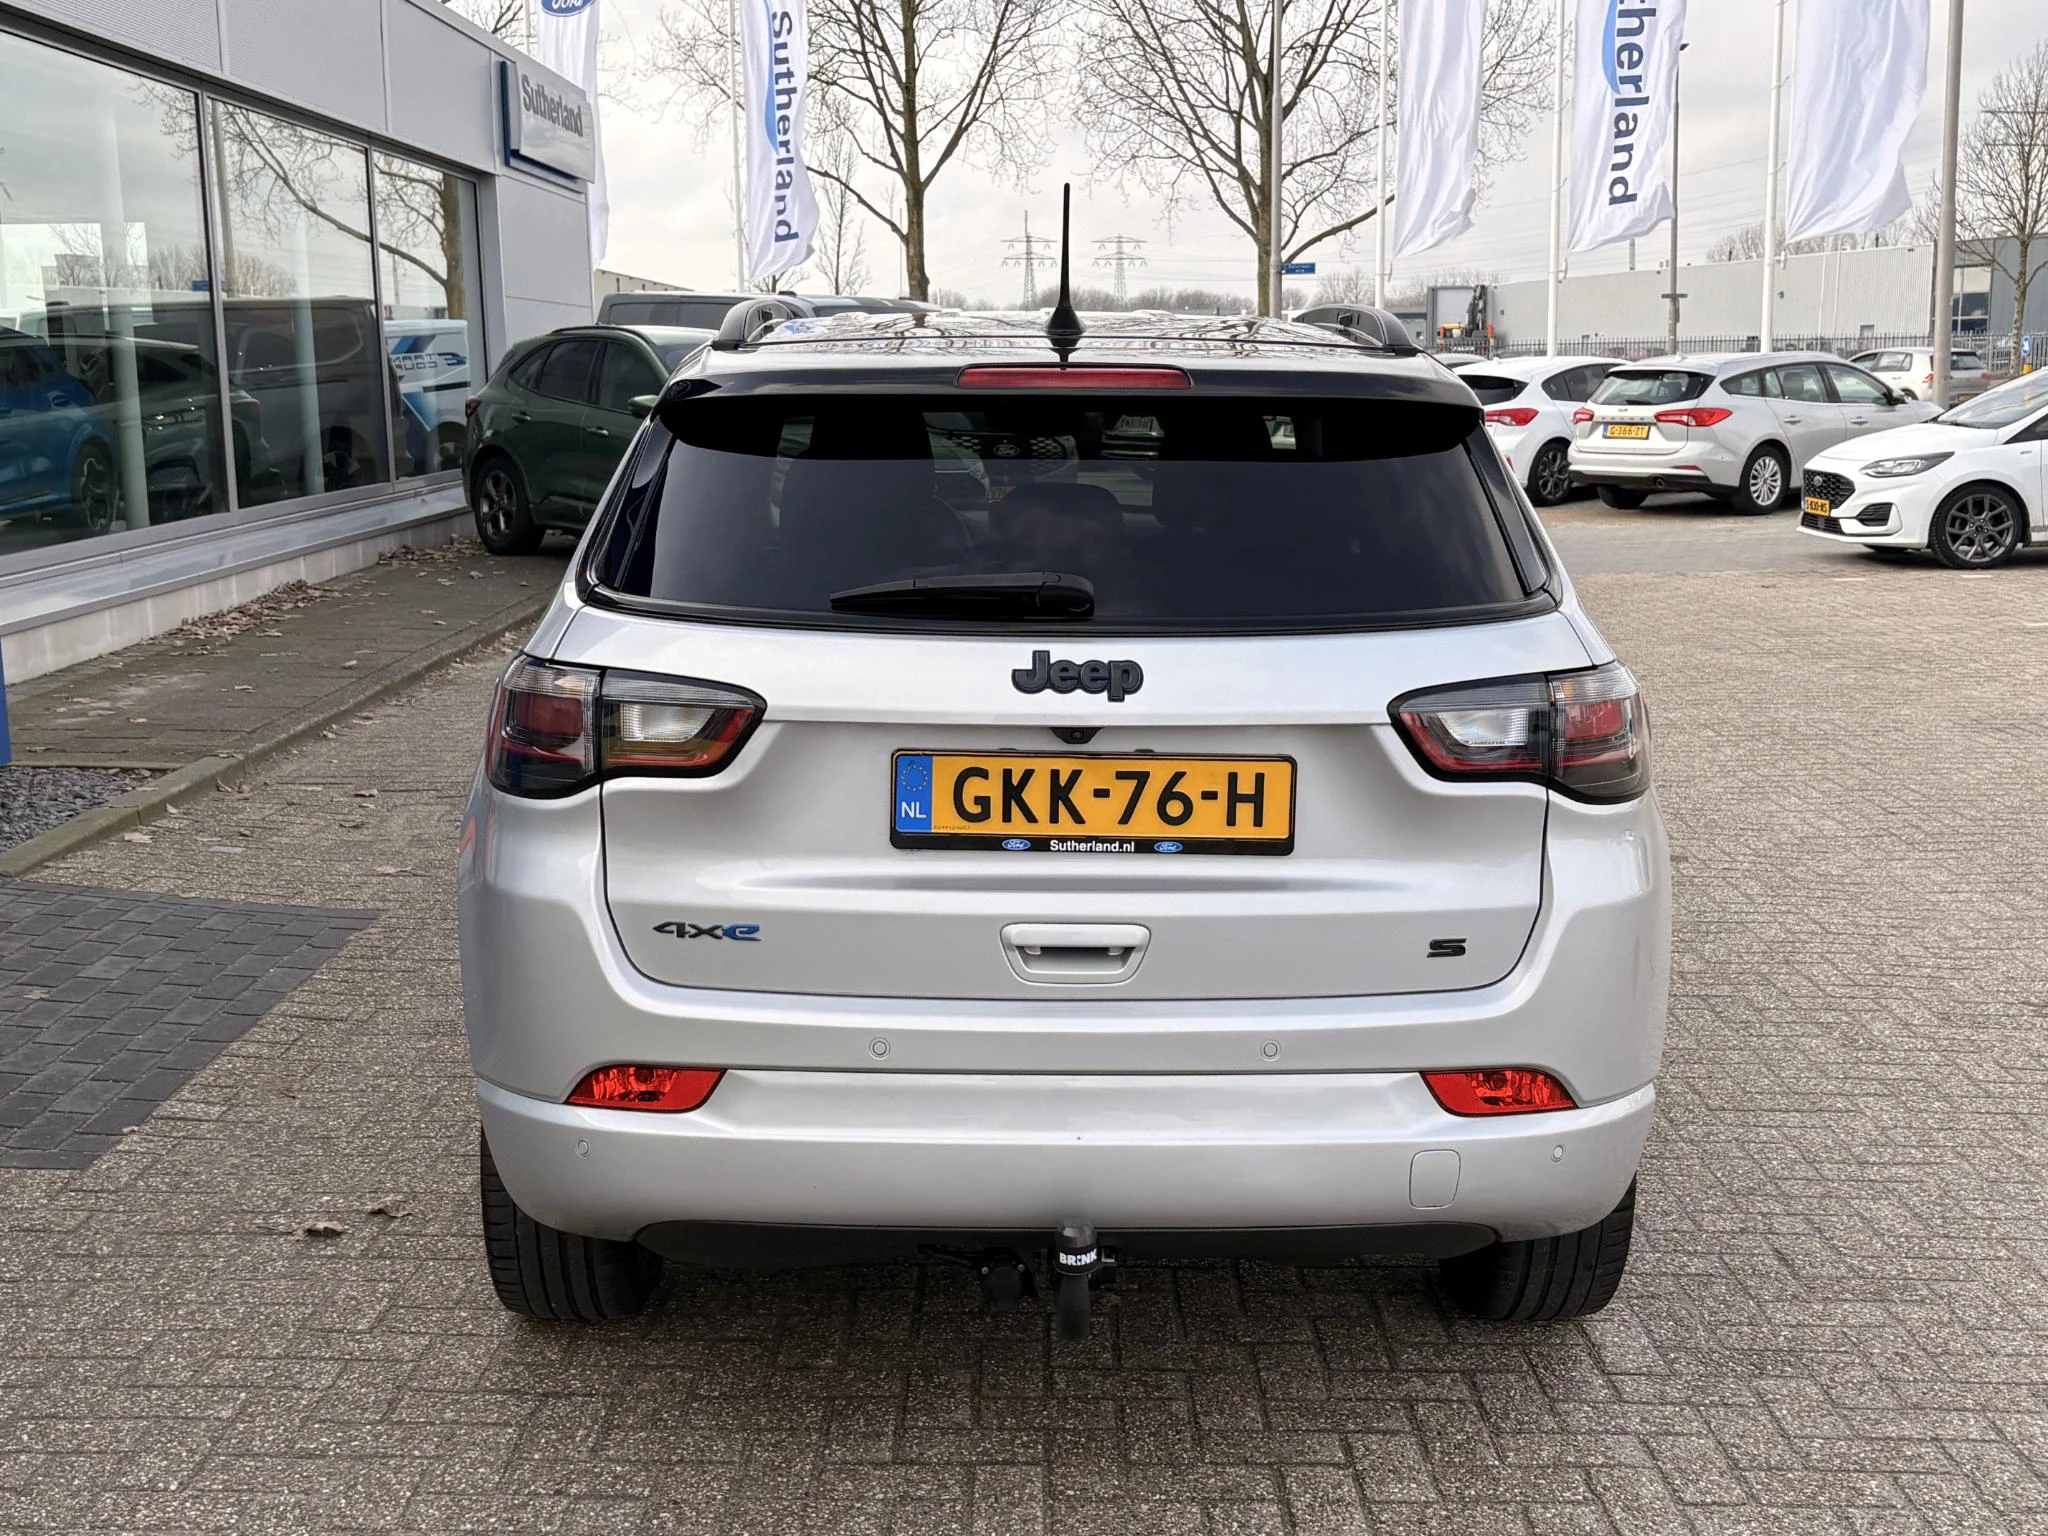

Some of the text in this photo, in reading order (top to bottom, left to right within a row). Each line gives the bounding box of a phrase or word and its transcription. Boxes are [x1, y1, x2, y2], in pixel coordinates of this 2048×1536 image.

[521, 74, 584, 137] Sutherland
[772, 11, 800, 243] Sutherland
[1011, 650, 1144, 702] Jeep
[953, 766, 1265, 827] GKK-76-H
[901, 801, 927, 818] NL
[1005, 840, 1028, 850] Ford
[1050, 839, 1135, 853] Sutherland.nl
[1157, 842, 1180, 852] Ford
[1426, 938, 1467, 958] S
[1059, 1248, 1098, 1266] BRINK
